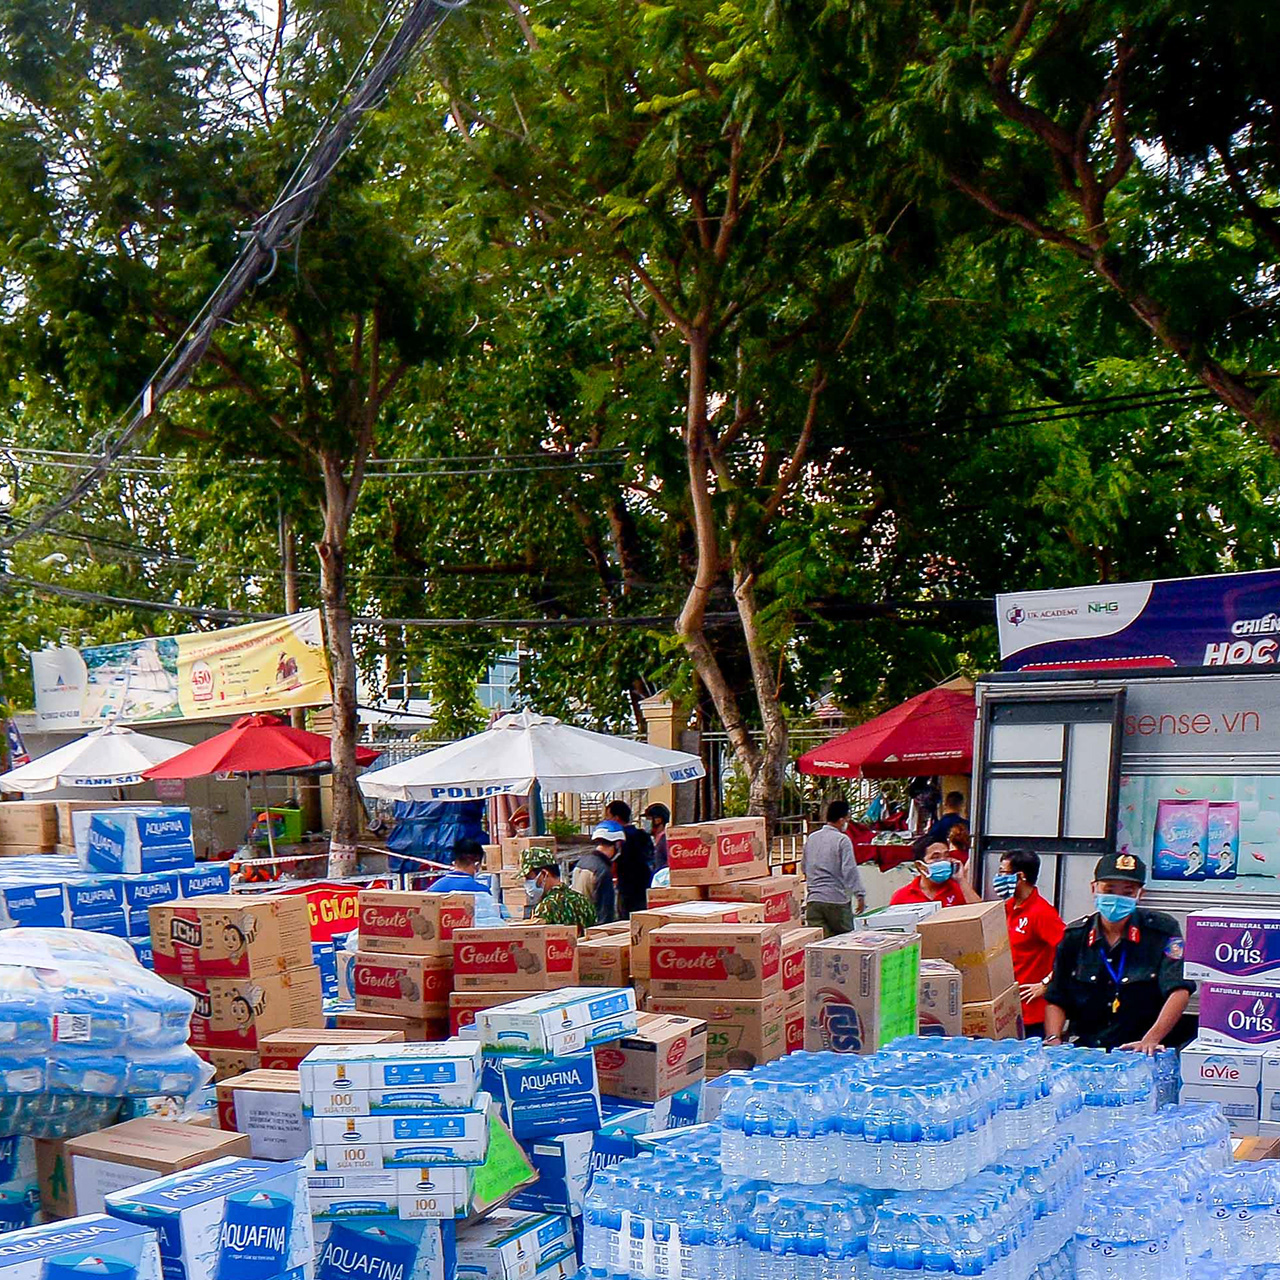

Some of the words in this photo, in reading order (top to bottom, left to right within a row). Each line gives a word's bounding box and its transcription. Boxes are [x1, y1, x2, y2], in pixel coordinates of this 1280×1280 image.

[1040, 608, 1079, 618] ACADEMY
[1087, 601, 1119, 614] NHG
[192, 668, 212, 687] 450
[144, 818, 186, 839] AQUAFINA
[134, 883, 174, 901] AQUAFINA
[186, 872, 226, 894] AQUAFINA
[76, 887, 117, 906] AQUAFINA
[362, 907, 407, 929] Gouté
[1196, 921, 1229, 929] NATURAL
[1230, 922, 1262, 930] MINERAL
[459, 940, 510, 965] Gouté
[655, 947, 718, 970] Gouté
[1214, 941, 1262, 964] Oris
[358, 966, 398, 989] Gouté
[1209, 987, 1242, 996] NATURAL
[1242, 989, 1274, 998] MINERAL
[1227, 1009, 1274, 1032] Oris
[521, 1069, 583, 1093] AQUAFINA
[1200, 1064, 1240, 1081] laVie
[330, 1093, 353, 1107] 100
[343, 1148, 366, 1162] 100
[164, 1161, 269, 1202] AQUAFINA
[415, 1198, 437, 1211] 100
[220, 1220, 287, 1256] AQUAFINA
